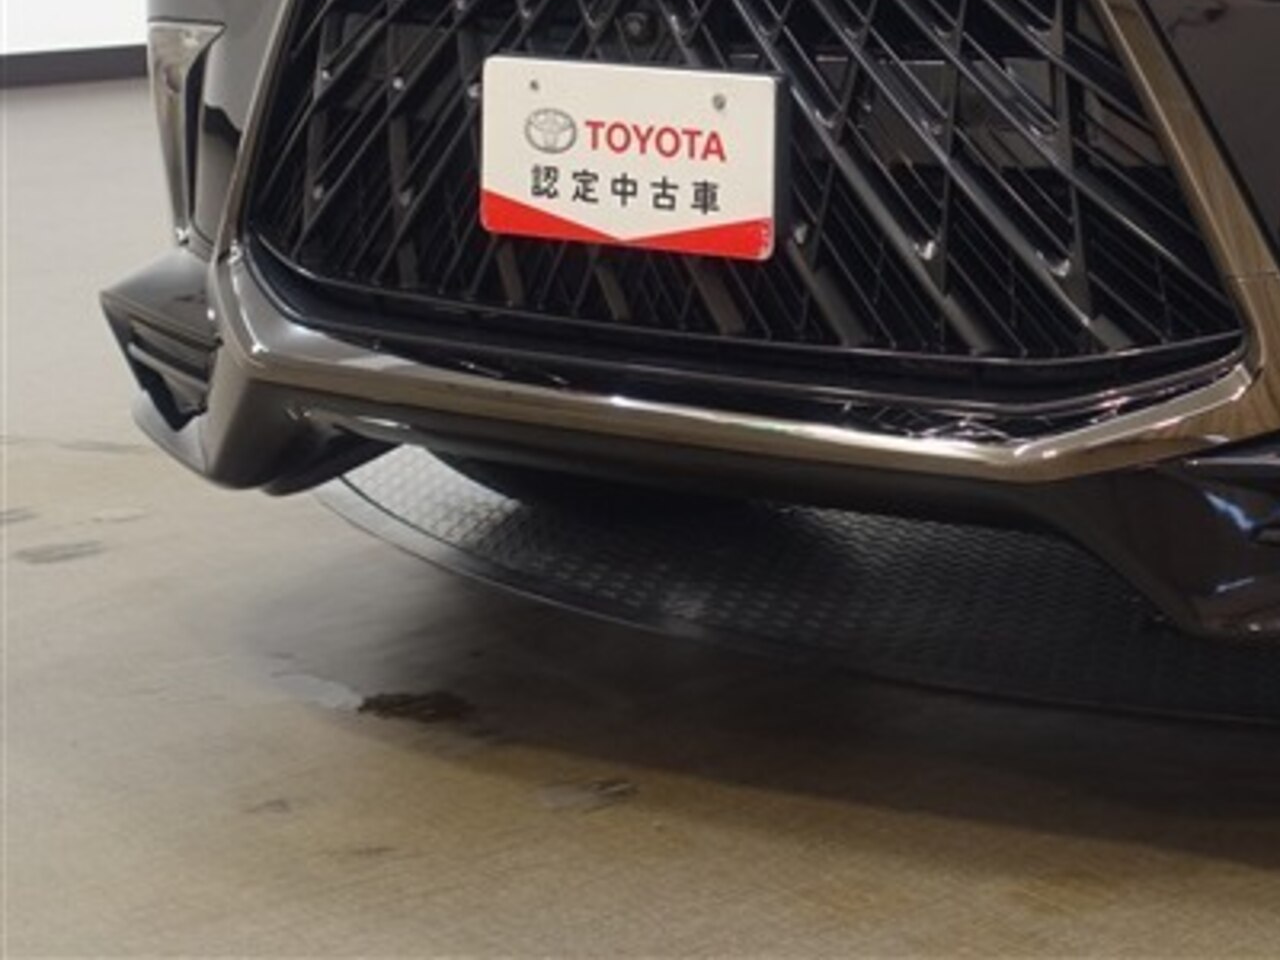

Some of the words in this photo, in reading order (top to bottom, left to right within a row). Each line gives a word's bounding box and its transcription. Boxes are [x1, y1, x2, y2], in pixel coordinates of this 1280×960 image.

[585, 120, 726, 162] TOYOTA
[531, 164, 720, 215] 認定中古車
